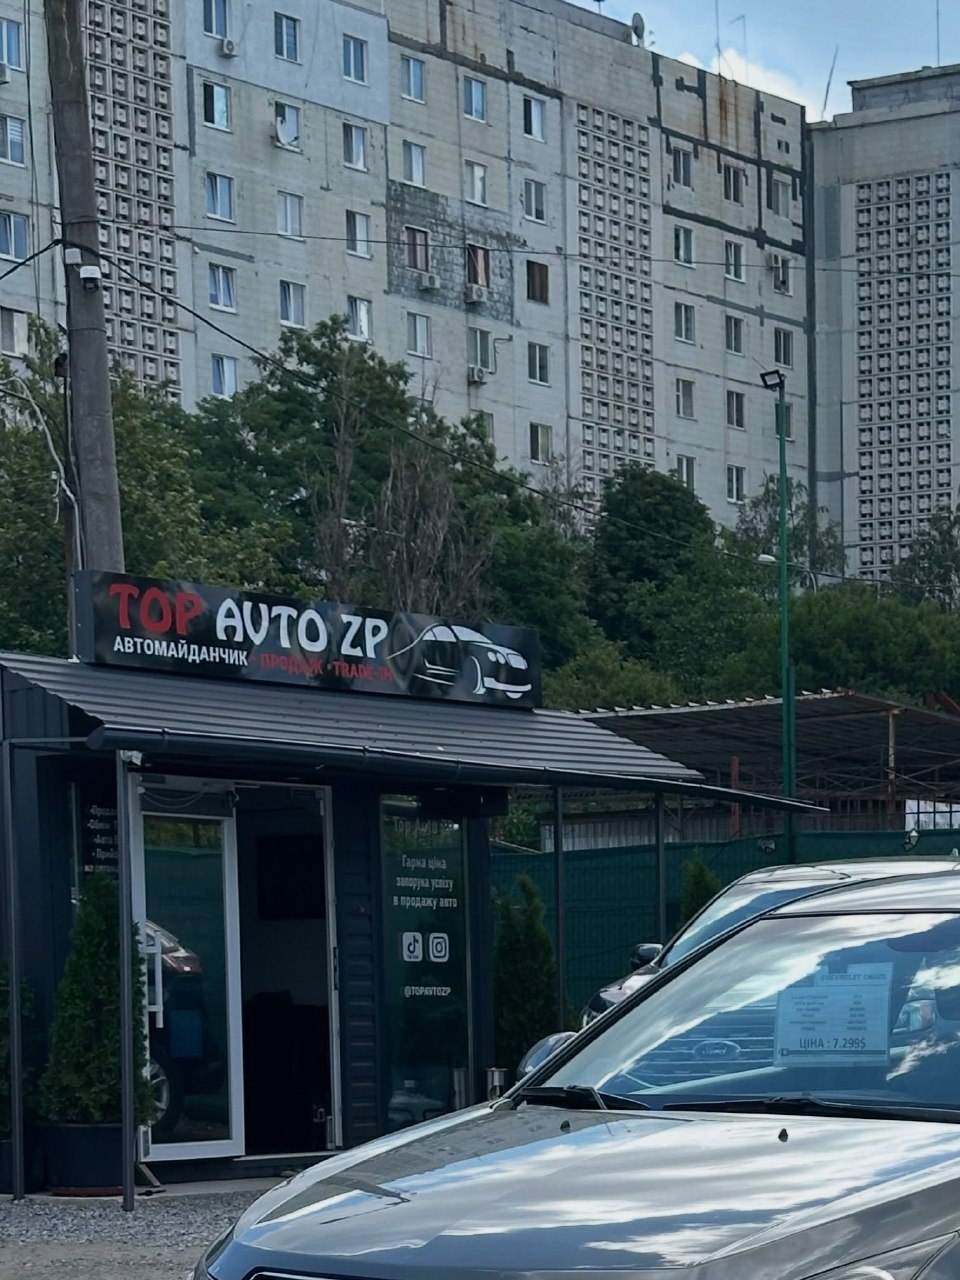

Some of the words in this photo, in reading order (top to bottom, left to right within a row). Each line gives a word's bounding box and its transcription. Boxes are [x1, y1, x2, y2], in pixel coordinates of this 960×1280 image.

[109, 583, 201, 636] TOP
[216, 598, 328, 653] AVTO
[340, 613, 388, 659] ZP
[113, 635, 249, 667] АВТОМАЙДАНЧИК
[799, 1038, 824, 1051] ЦІНА
